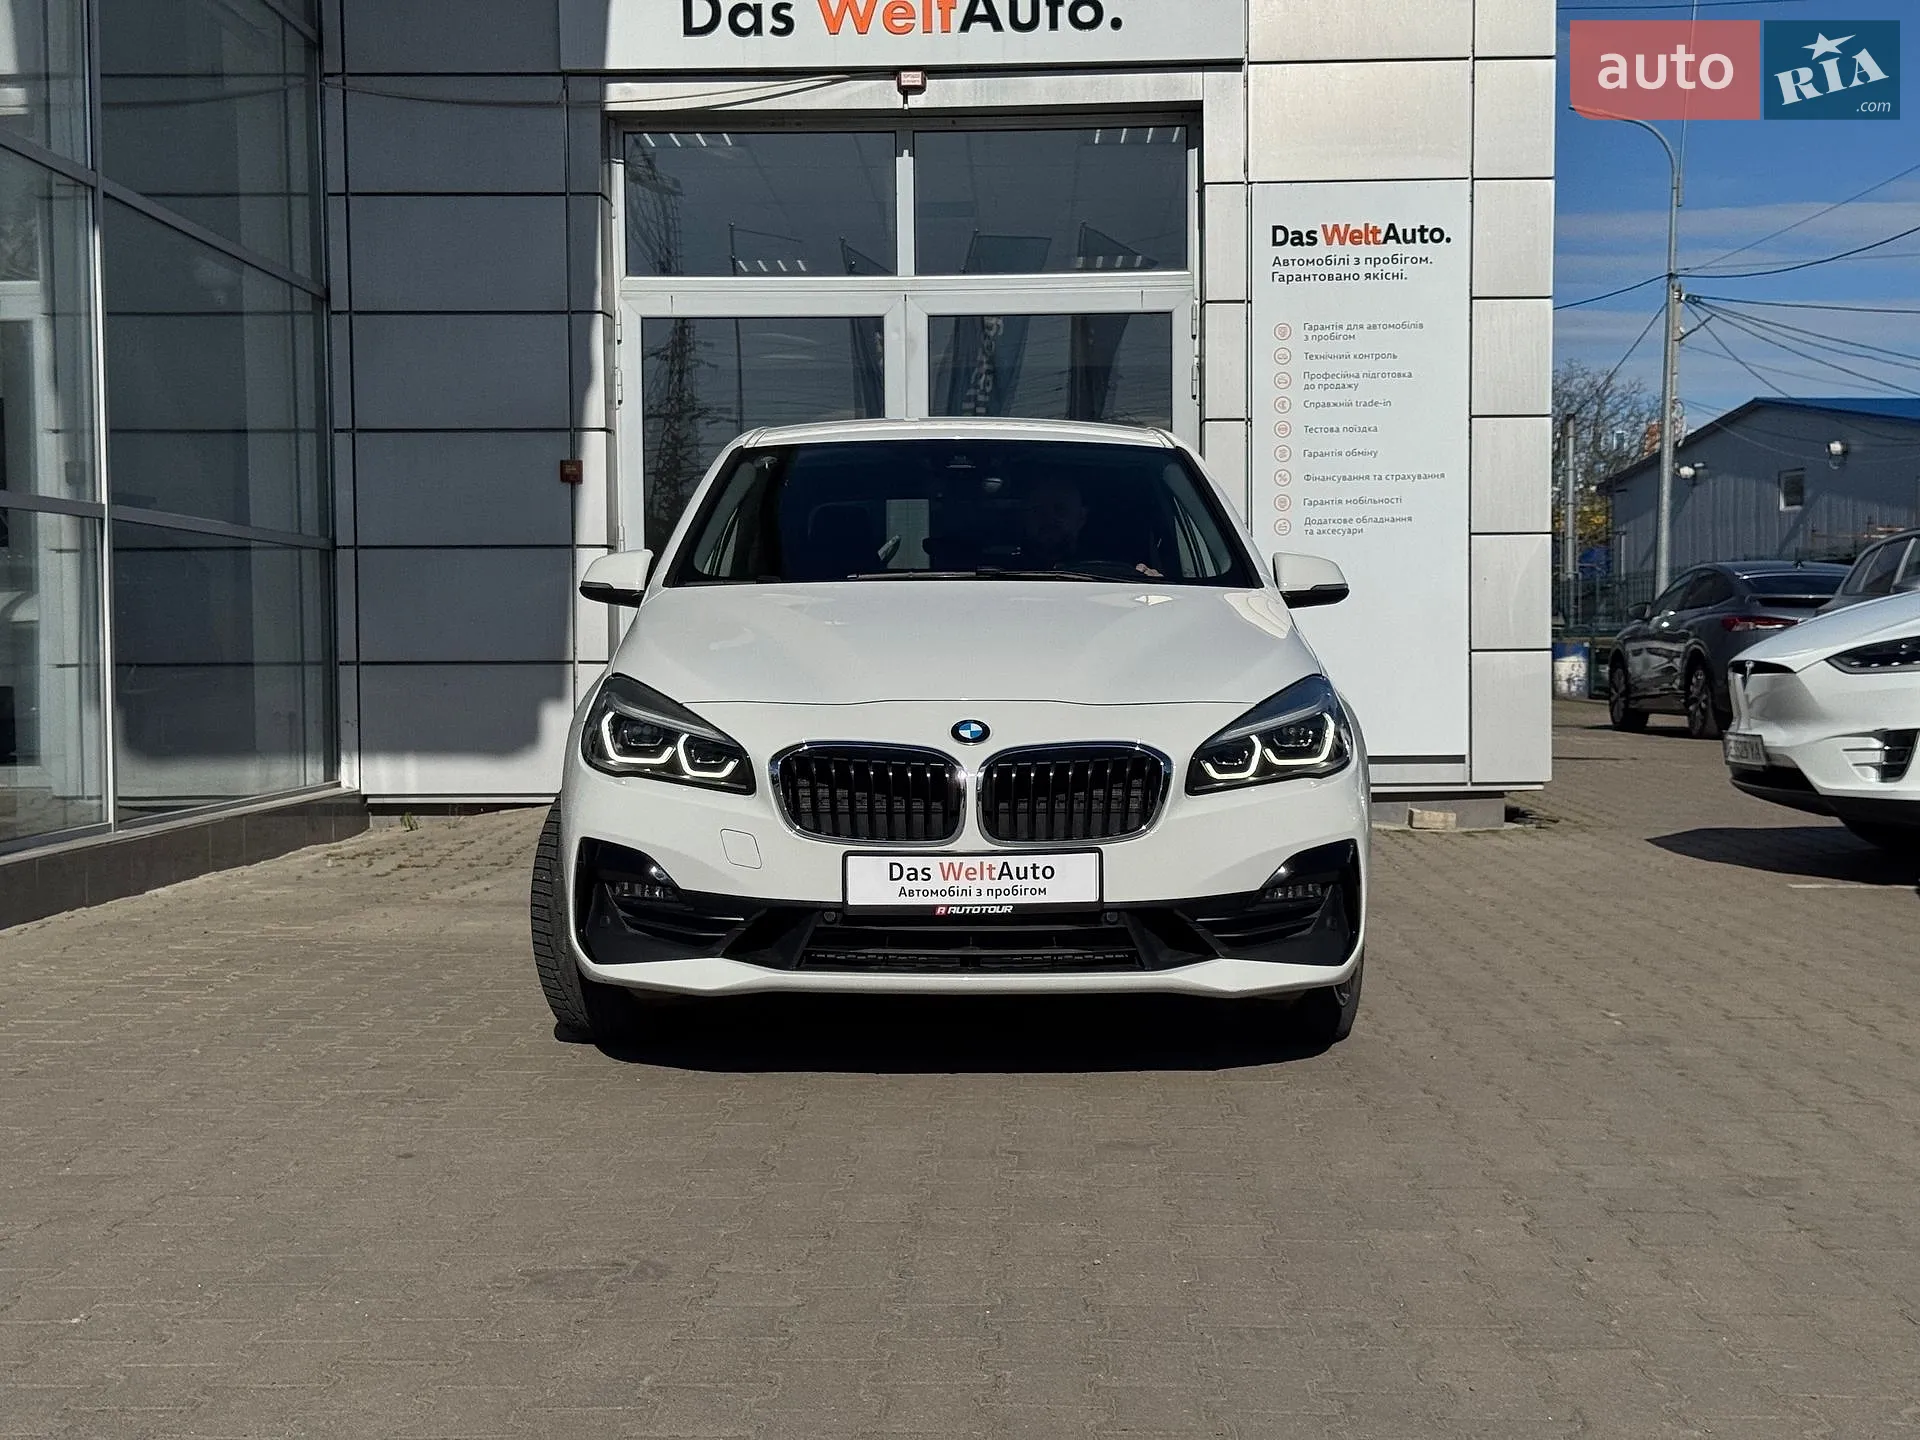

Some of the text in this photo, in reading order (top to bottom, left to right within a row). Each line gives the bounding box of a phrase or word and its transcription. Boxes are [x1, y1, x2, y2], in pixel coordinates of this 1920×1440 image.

[682, 0, 1123, 38] Das WeltAuto.
[1271, 223, 1452, 247] Das WeltAuto.
[1272, 253, 1434, 268] Автомобілі з пробігом.
[1271, 269, 1408, 284] Гарантовано якісні.
[1303, 322, 1344, 332] Гарантія
[1346, 322, 1364, 331] для
[1353, 352, 1398, 361] контроль
[1303, 382, 1316, 391] до
[1355, 399, 1392, 408] trade-in
[1303, 425, 1340, 433] Тестова
[1303, 449, 1343, 459] Гарантія
[1373, 473, 1383, 481] та
[1303, 497, 1343, 507] Гарантія
[888, 861, 1055, 881] Das WeltAuto
[898, 885, 1047, 899] Автомобілі з пробігом
[947, 905, 1013, 914] AUTOTOUR
